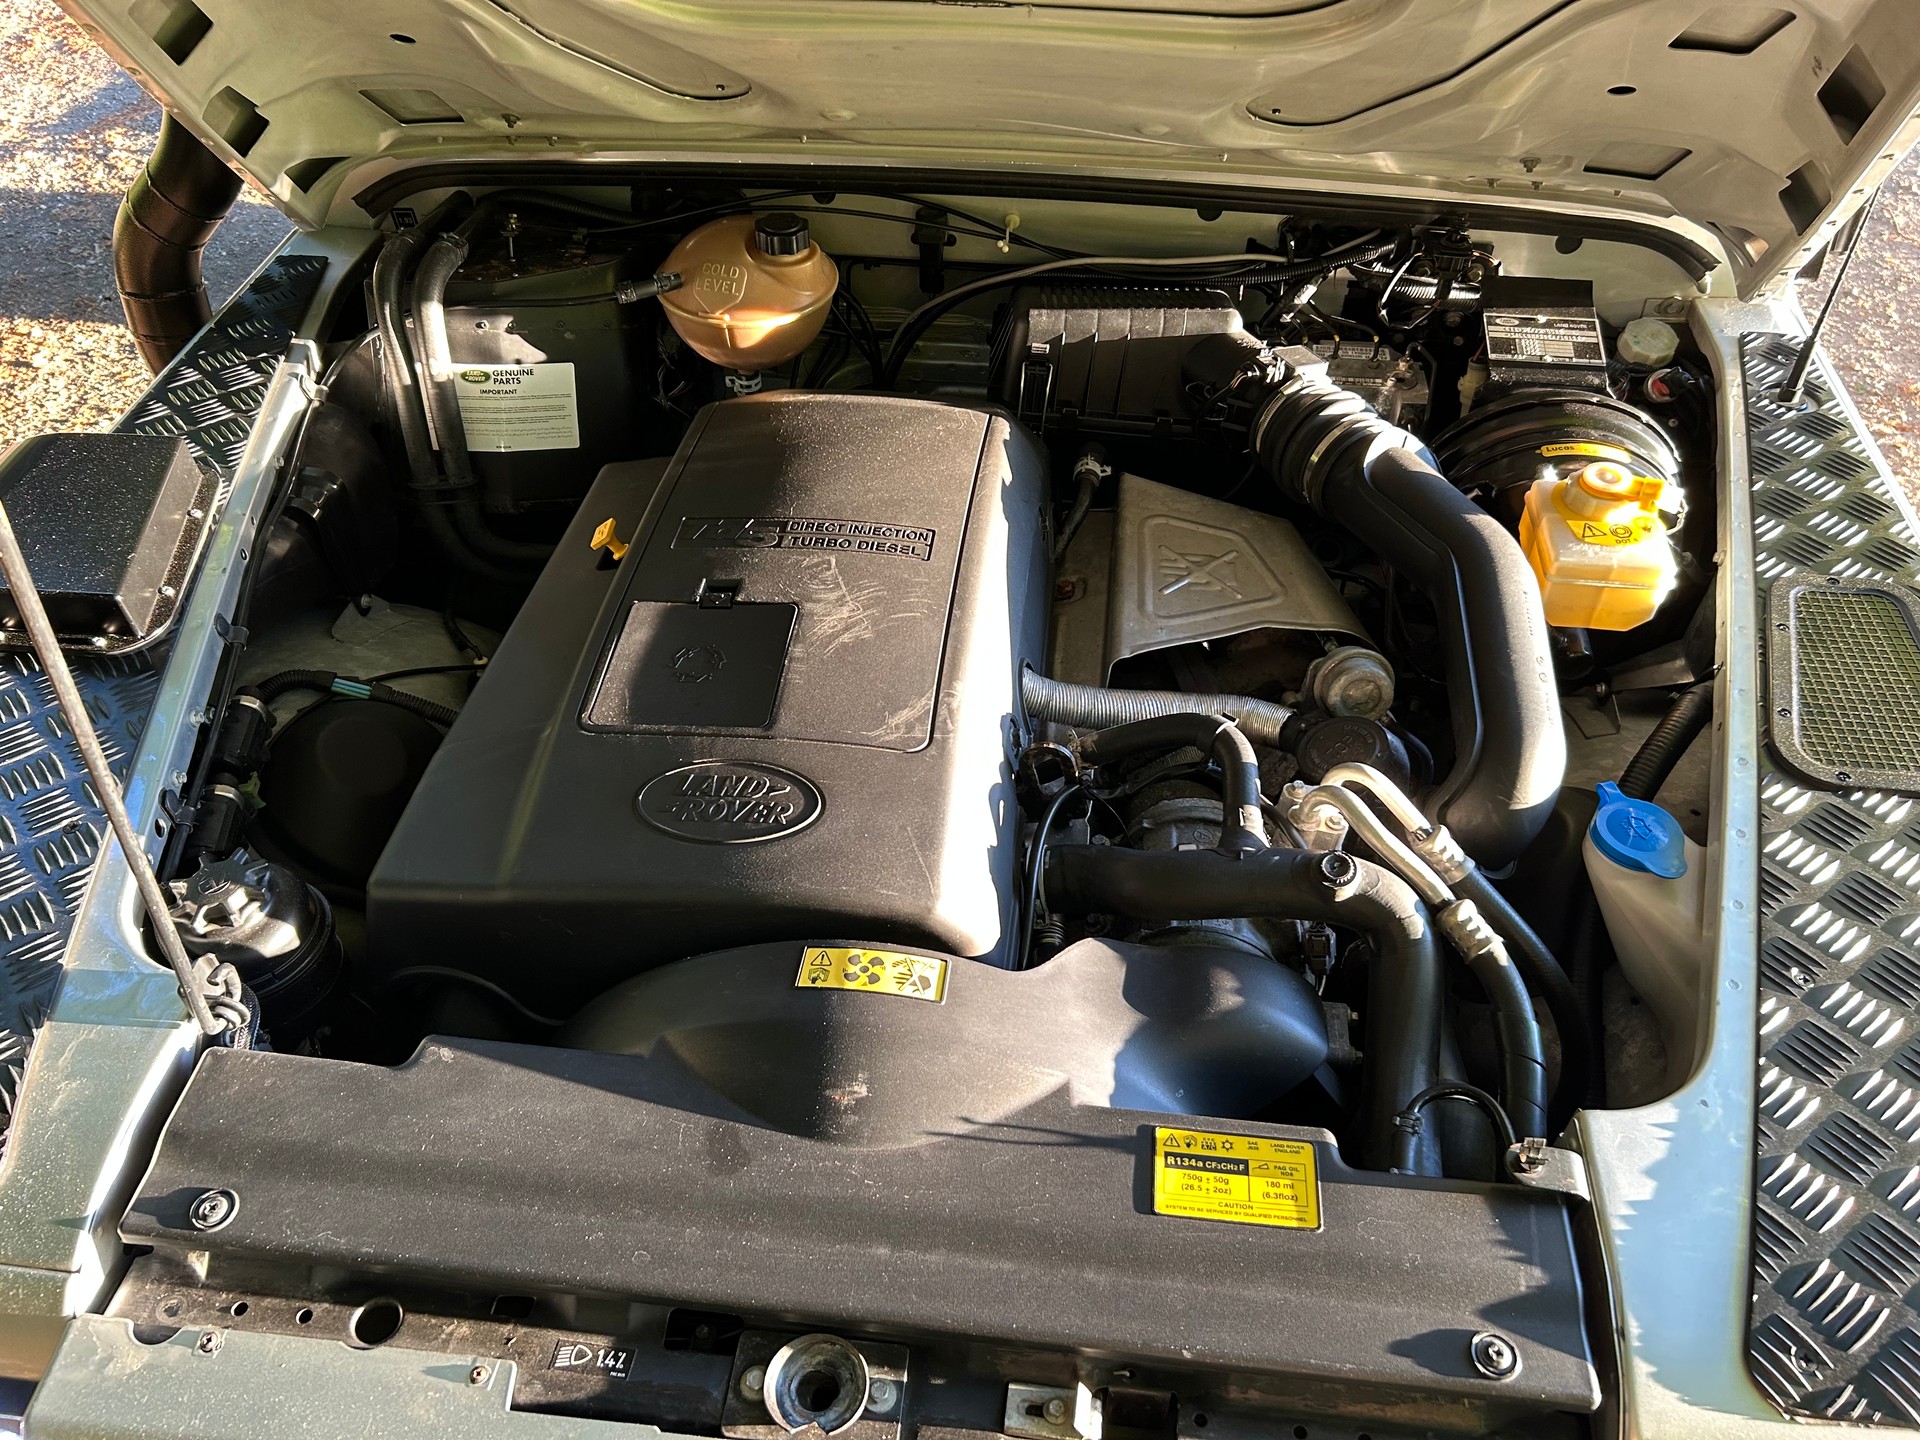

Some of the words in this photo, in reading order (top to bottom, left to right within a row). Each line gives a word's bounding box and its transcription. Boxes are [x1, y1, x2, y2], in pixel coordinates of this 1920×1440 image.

[702, 262, 740, 279] COLD
[695, 277, 739, 296] LEVEL
[492, 368, 535, 377] GENUINE
[493, 377, 522, 385] PARTS
[787, 520, 846, 534] DIRECT
[846, 523, 930, 543] INJECTION
[787, 535, 853, 549] TURBO
[855, 539, 921, 556] DIESEL
[676, 773, 770, 799] LAND
[679, 798, 794, 825] ROVER
[1166, 1155, 1203, 1168] R134a
[1182, 1173, 1203, 1183] 750g
[1213, 1175, 1229, 1185] 50g
[1265, 1180, 1281, 1189] 180
[1283, 1182, 1294, 1190] ml
[1181, 1183, 1203, 1192] (26.5
[1213, 1186, 1232, 1195] 2oz)
[1262, 1191, 1298, 1202] (6.3floz)
[1218, 1201, 1254, 1210] CAUTION
[1243, 1211, 1272, 1219] QUALIFIED
[1273, 1214, 1308, 1222] PERSONNEL
